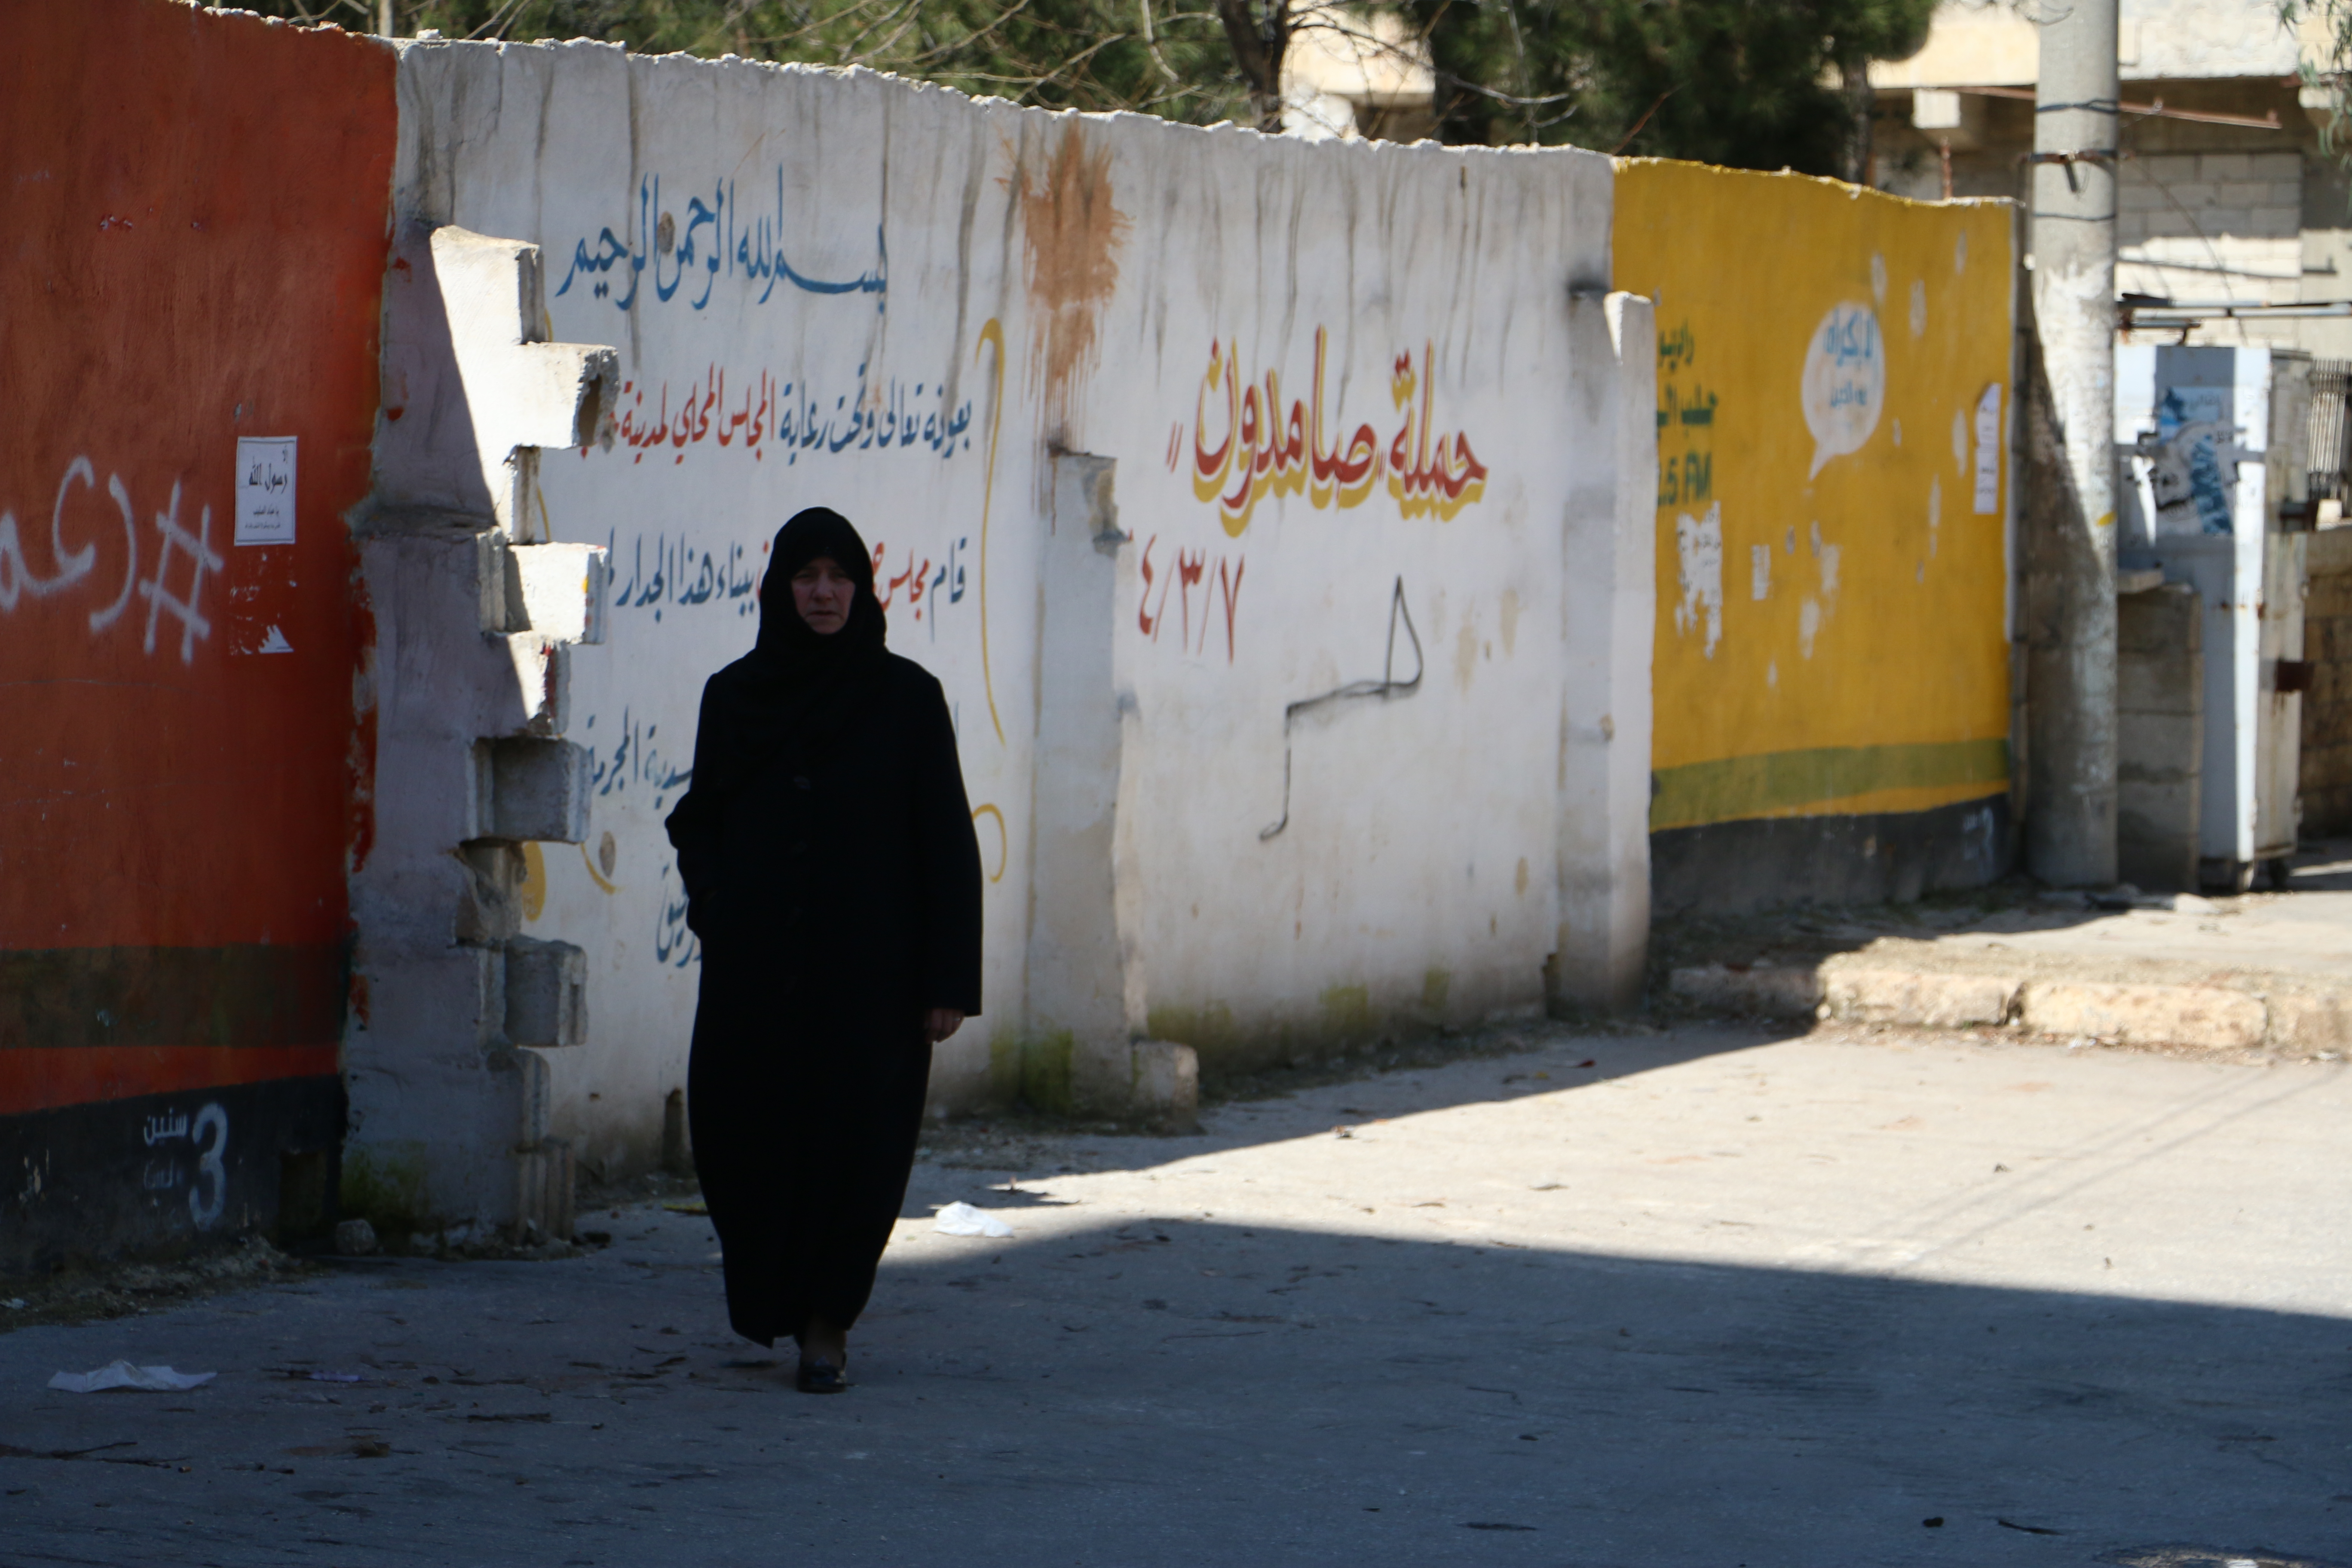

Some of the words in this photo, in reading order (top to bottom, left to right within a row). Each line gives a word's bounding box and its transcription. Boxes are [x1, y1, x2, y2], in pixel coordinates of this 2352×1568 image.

[555, 173, 659, 310] الرحيم
[656, 177, 734, 309] الرحمن
[738, 162, 783, 278] الله
[621, 379, 668, 466] لمدينة
[672, 361, 724, 466] المحلي
[718, 367, 776, 462] المجلس
[780, 379, 829, 466] رعاية
[830, 363, 875, 453] وتحت
[924, 384, 971, 459] بعونه
[1389, 338, 1488, 518] حملة
[249, 456, 262, 486] الله
[265, 462, 288, 494] رسول
[615, 531, 674, 623] الجدار
[678, 532, 714, 605] هذا
[879, 548, 931, 622] مجلس
[929, 536, 968, 643] قام
[144, 1107, 188, 1147] سنين
